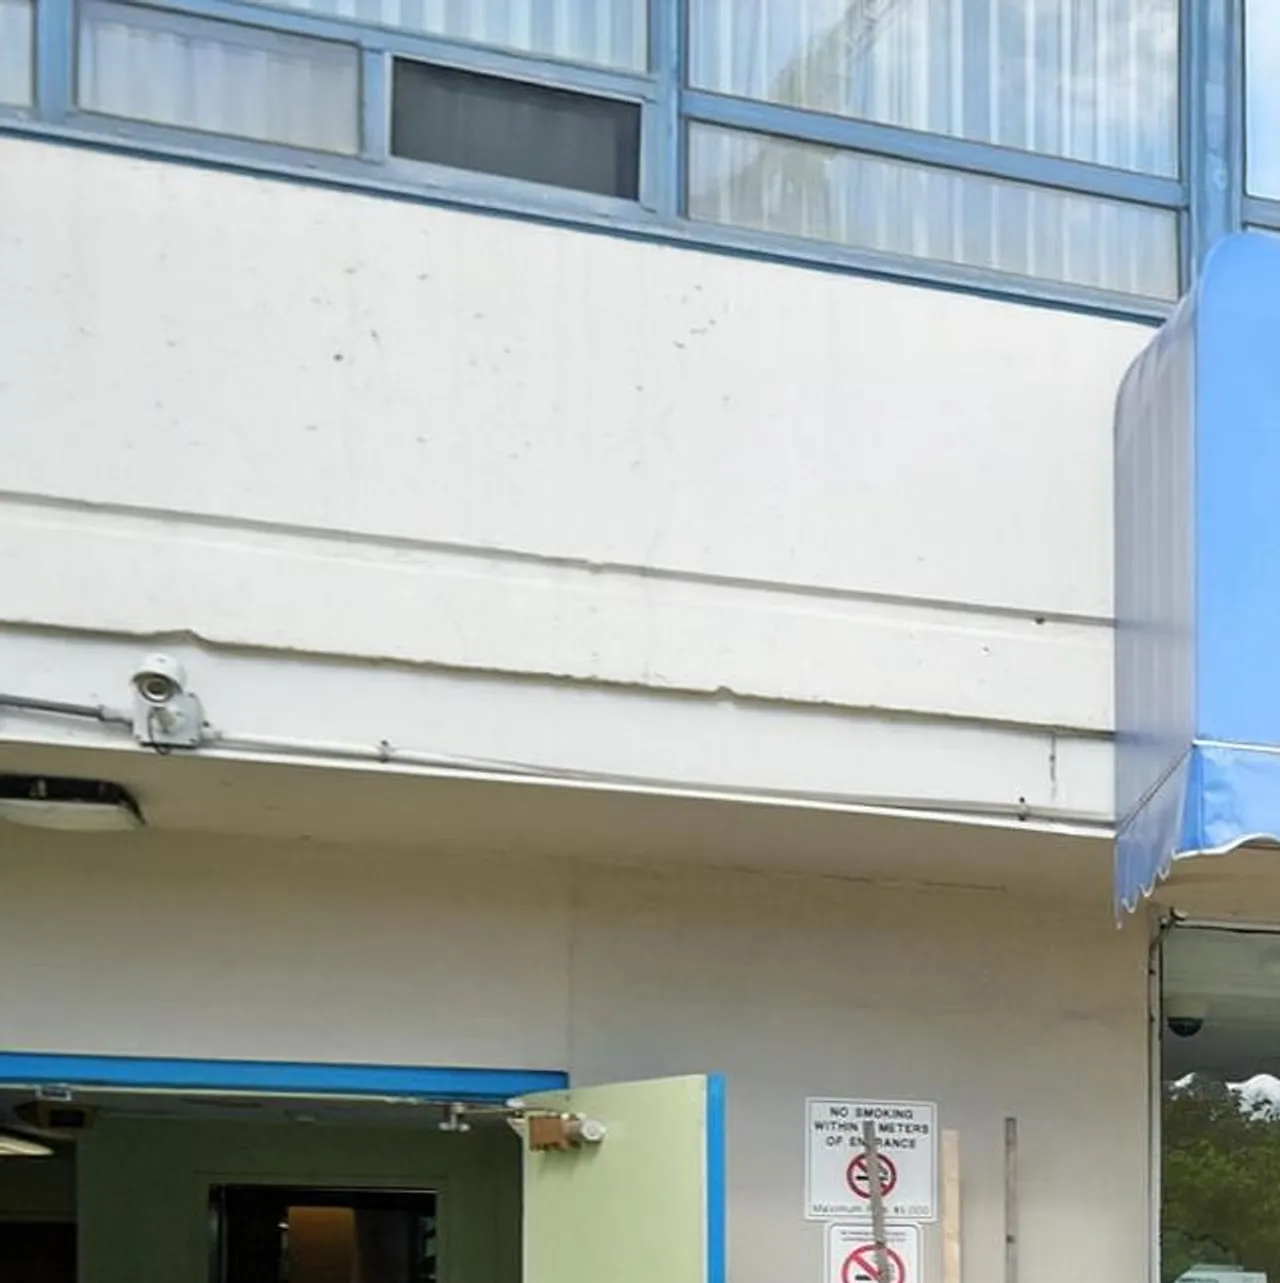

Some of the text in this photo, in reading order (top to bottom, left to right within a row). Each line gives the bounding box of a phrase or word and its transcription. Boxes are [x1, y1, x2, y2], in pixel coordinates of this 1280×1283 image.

[830, 1106, 914, 1119] NO SMOKING
[814, 1121, 929, 1135] WITHIN METERS
[826, 1135, 916, 1149] OF ENRANCE
